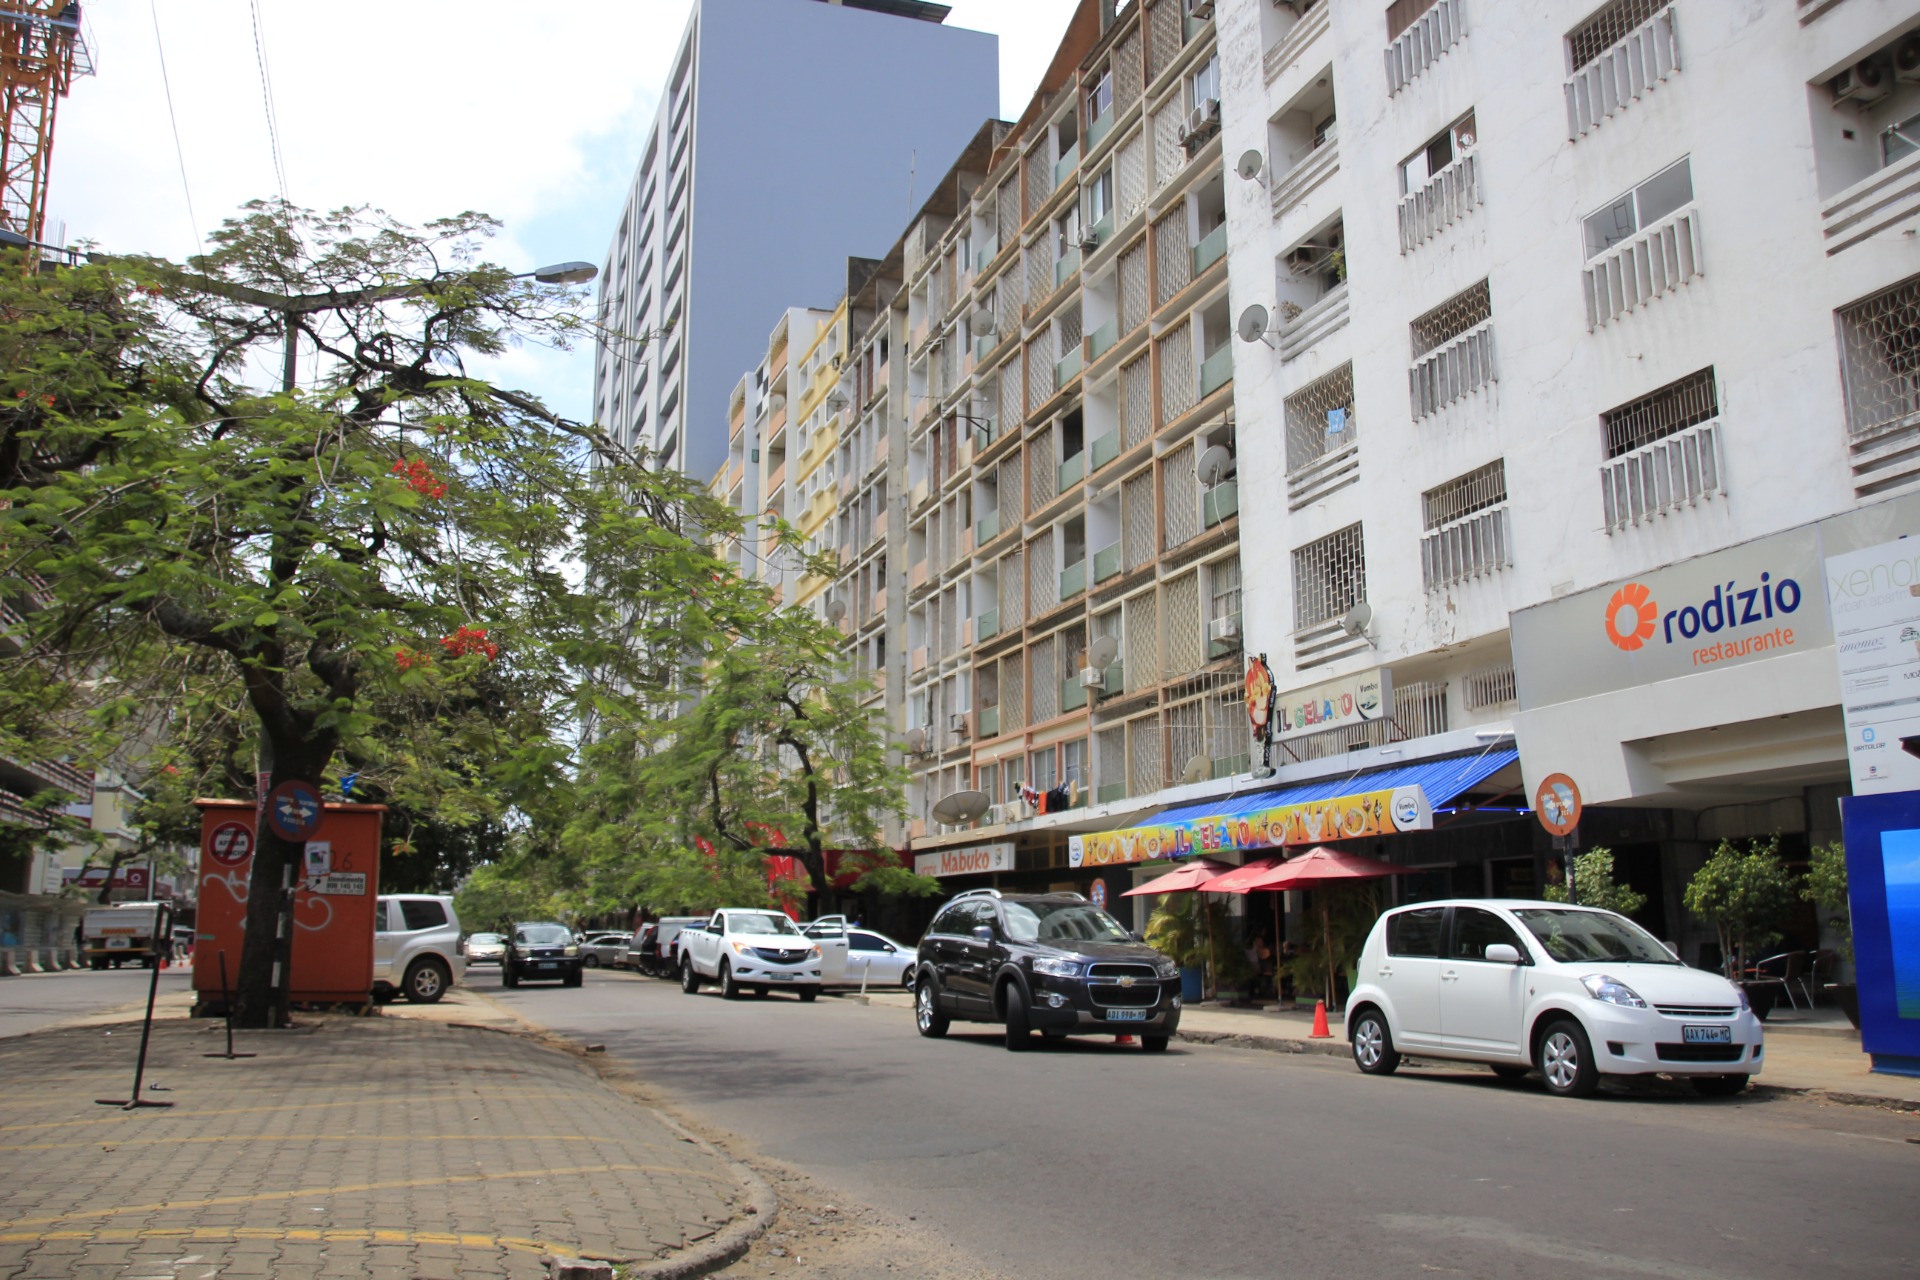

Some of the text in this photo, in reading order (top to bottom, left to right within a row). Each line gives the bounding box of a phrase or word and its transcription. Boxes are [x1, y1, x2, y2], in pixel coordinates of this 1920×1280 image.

[1663, 572, 1801, 644] rodízio
[1692, 628, 1794, 666] restaurante
[1840, 637, 1884, 653] imomoz
[1276, 692, 1353, 733] IL GELATO
[1854, 742, 1886, 752] BRITALAR
[1175, 816, 1250, 856] IL GELATO
[941, 848, 990, 873] Mabuko
[1686, 1029, 1730, 1040] AAX 744 MC
